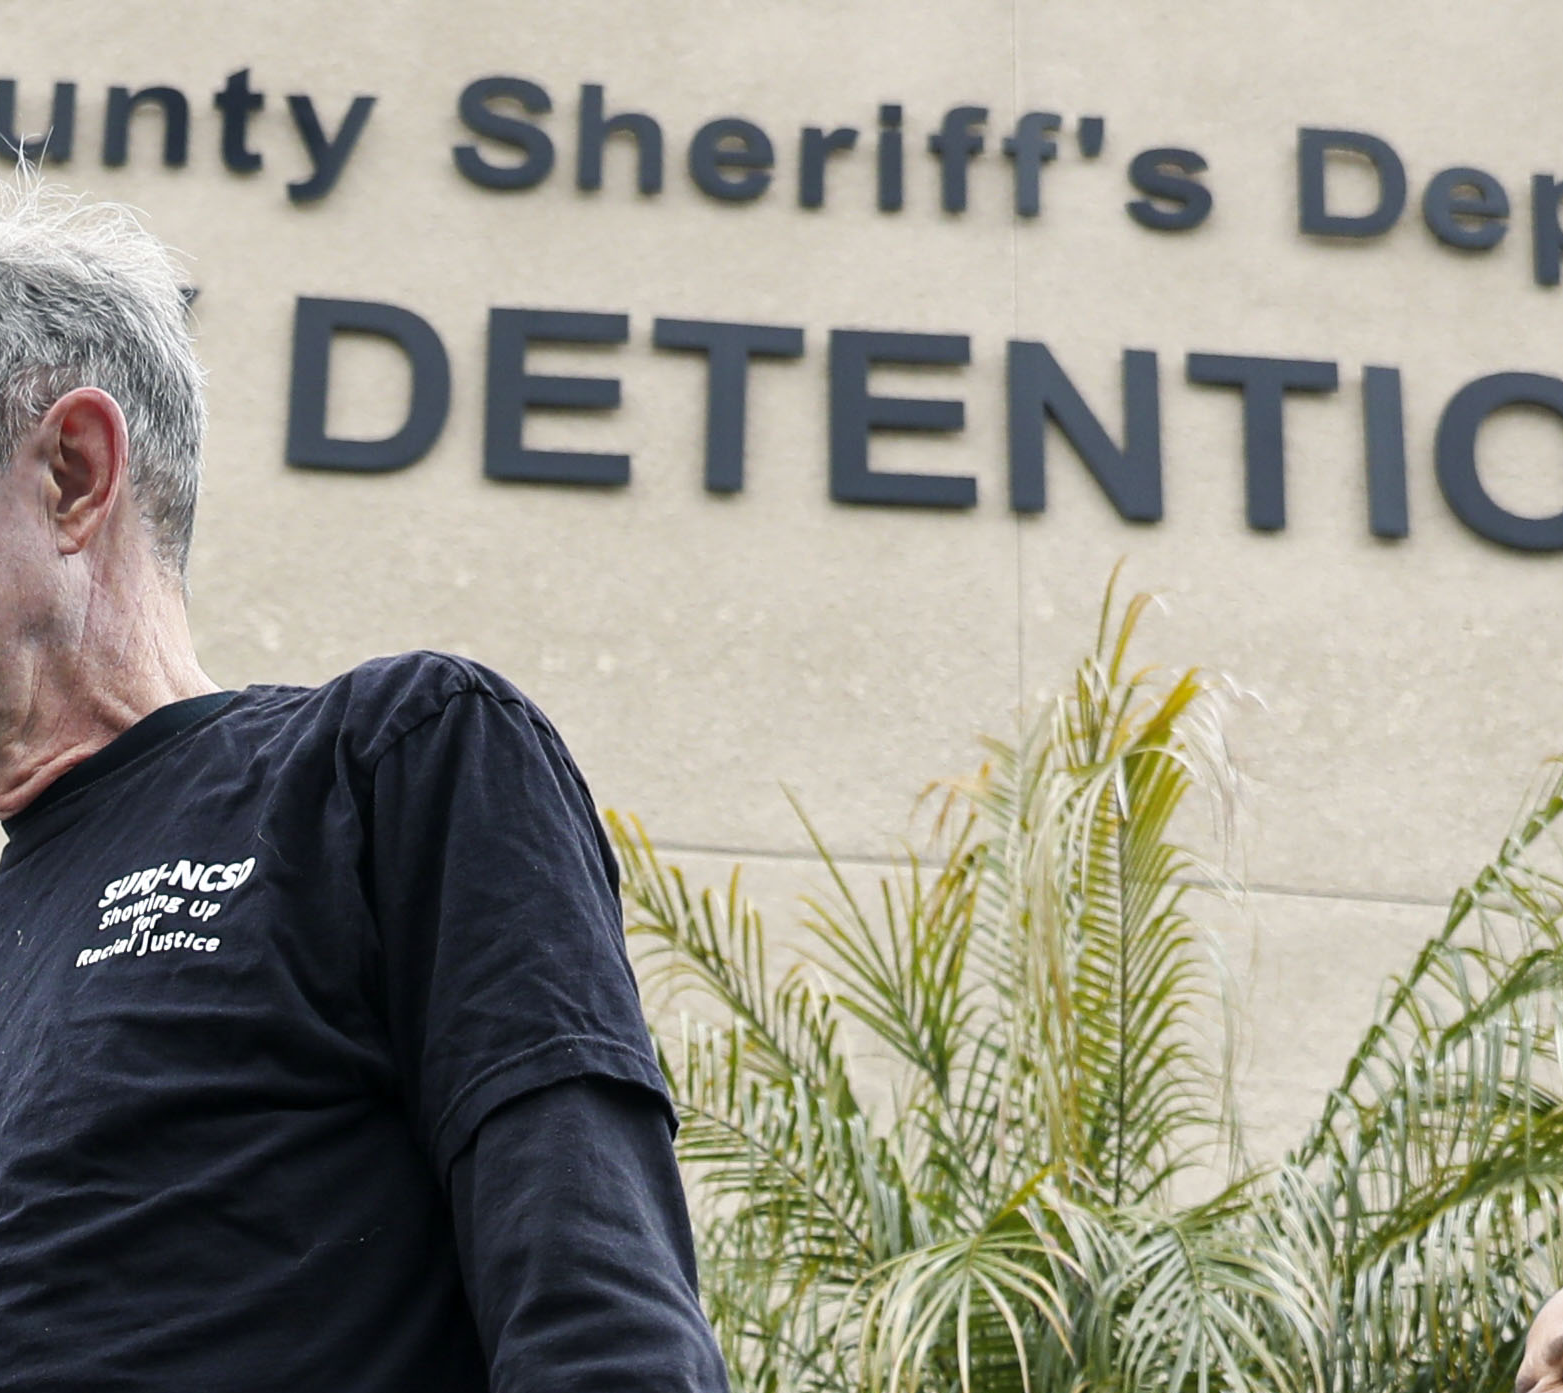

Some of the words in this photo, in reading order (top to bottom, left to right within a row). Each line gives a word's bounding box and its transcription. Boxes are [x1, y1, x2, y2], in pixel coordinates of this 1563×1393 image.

[453, 76, 1213, 232] Sheriff's
[131, 913, 163, 935] for
[75, 932, 138, 968] Racial
[136, 929, 221, 958] Justice
